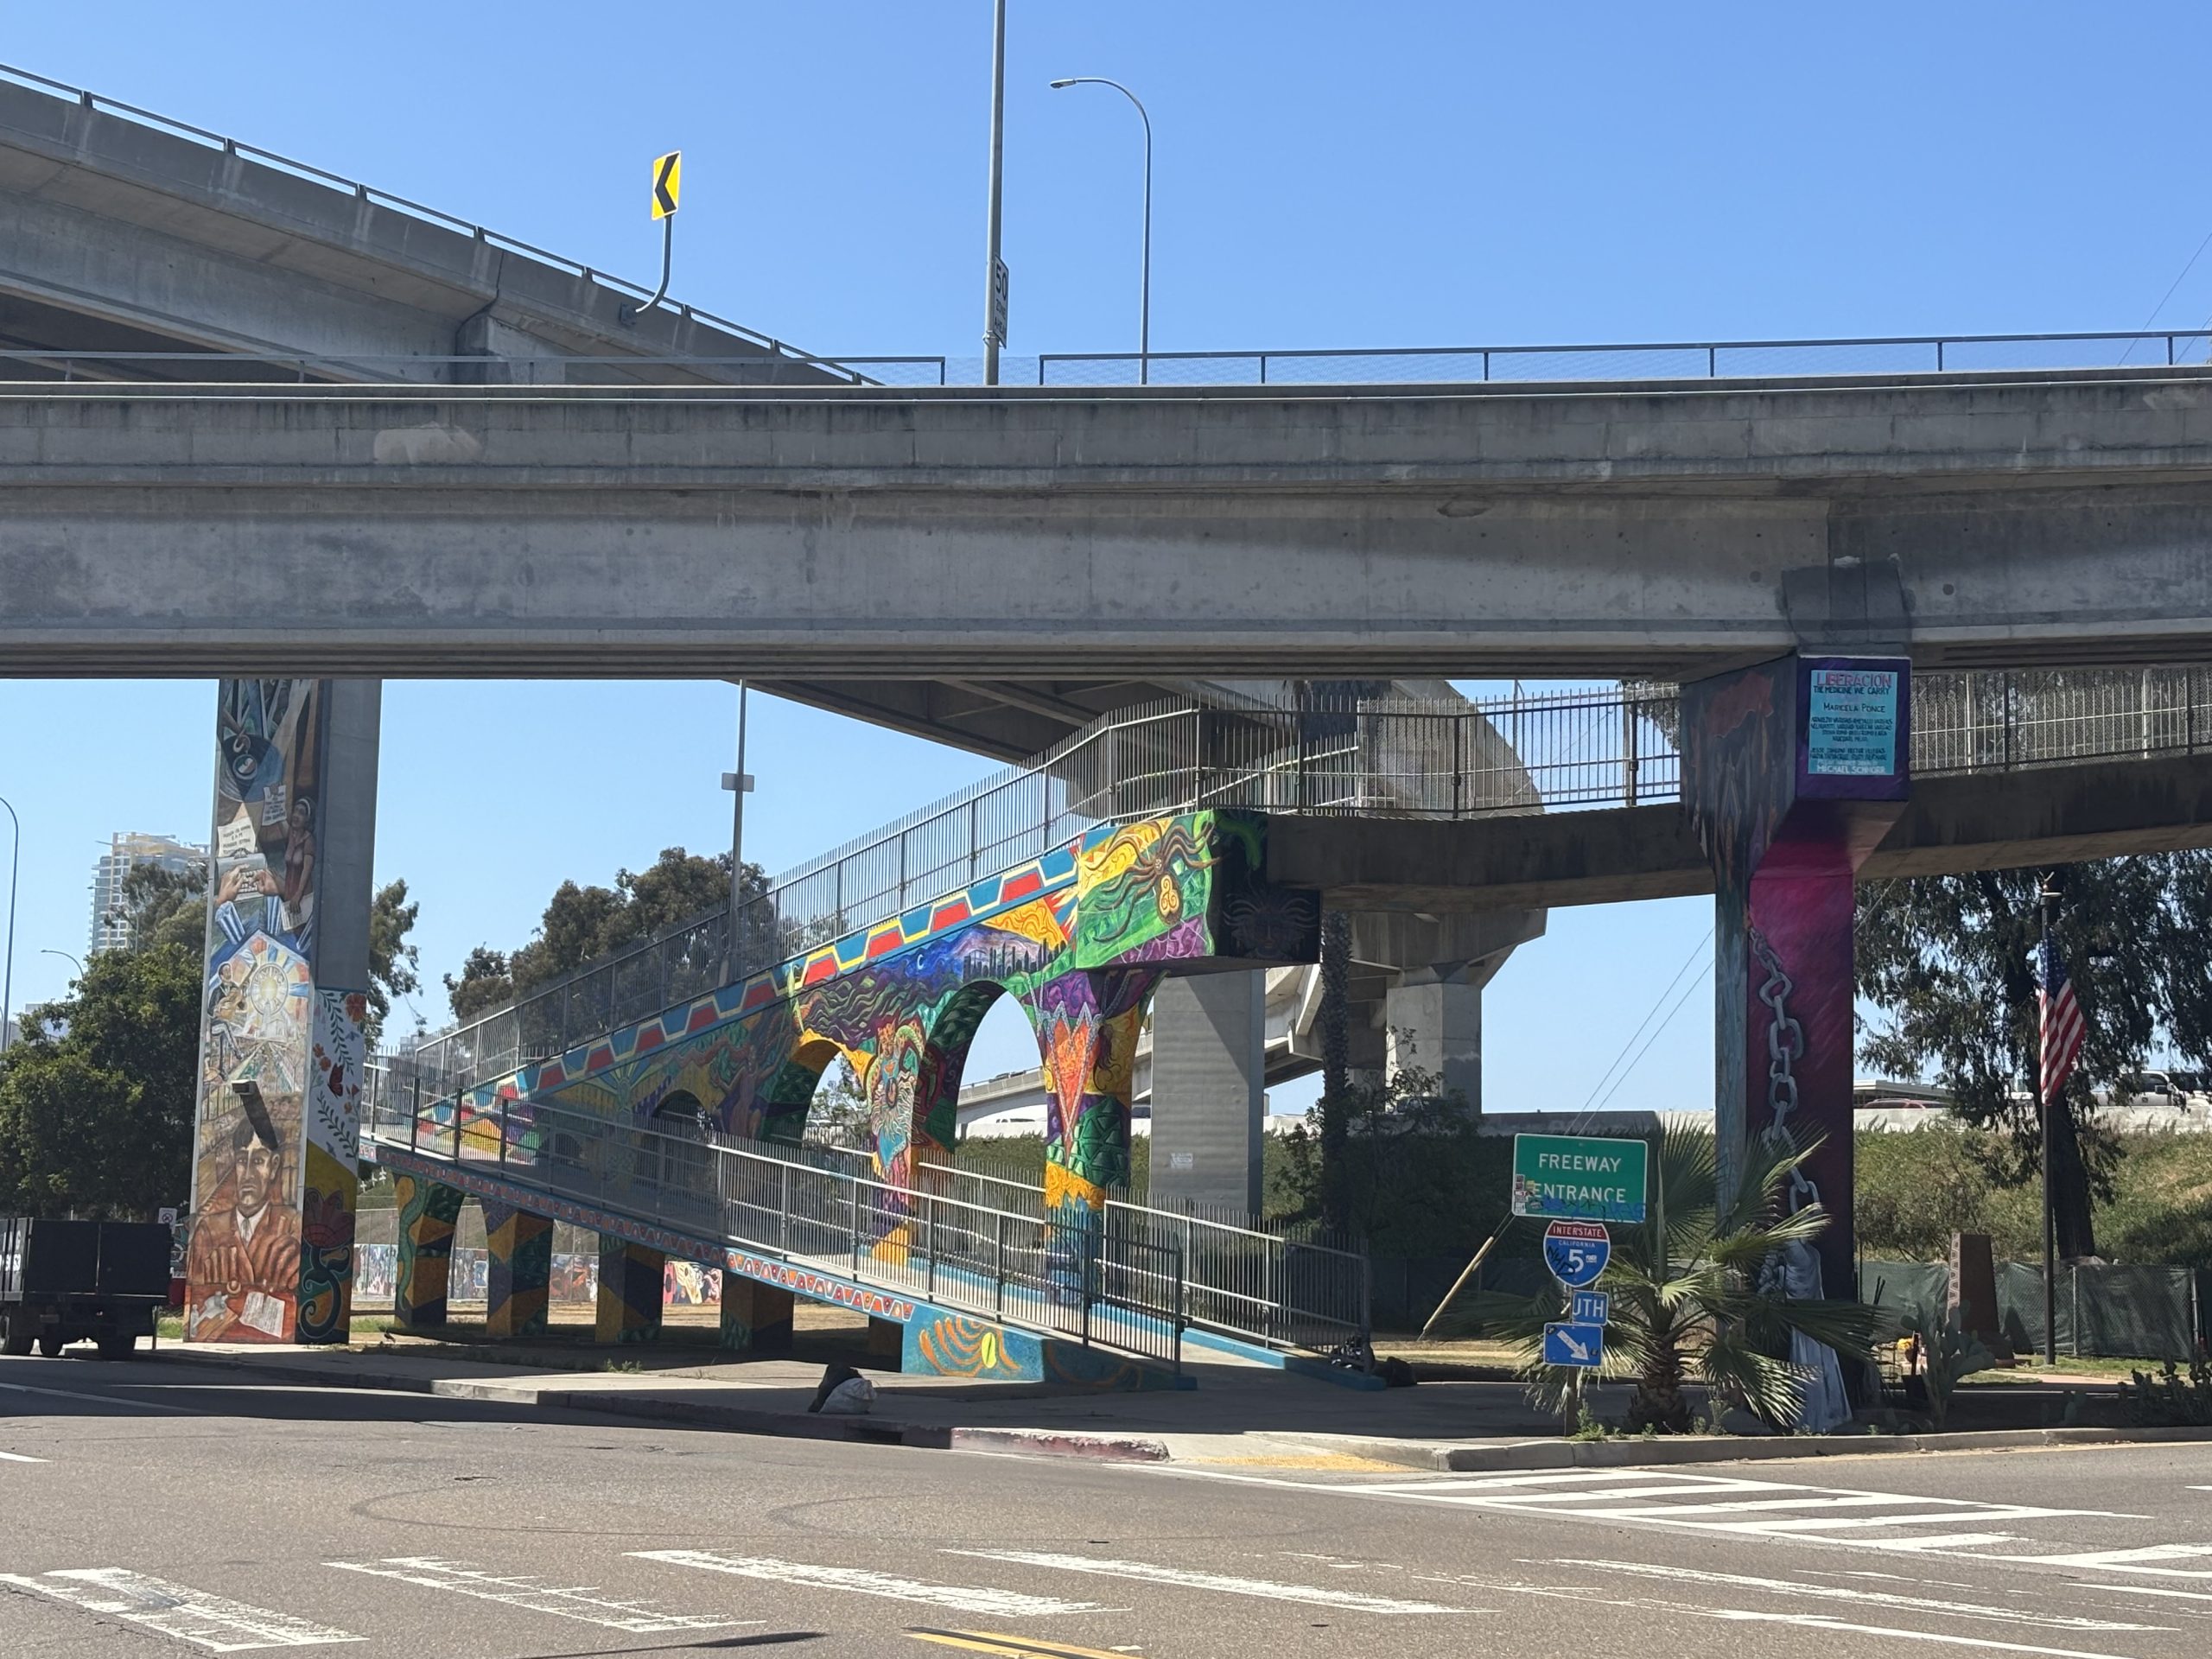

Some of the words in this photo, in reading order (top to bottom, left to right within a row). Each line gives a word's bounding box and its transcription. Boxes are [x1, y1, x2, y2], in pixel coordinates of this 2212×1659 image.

[995, 263, 1007, 301] 50
[1867, 686, 1890, 695] CARRY
[1862, 703, 1885, 713] PONCE
[1539, 1153, 1621, 1173] FREEWAY
[1531, 1183, 1626, 1203] ENTRANCE
[1553, 1225, 1602, 1237] INTERSTATE
[1558, 1239, 1595, 1248] CALIFORNIA
[1568, 1249, 1584, 1273] 5
[1573, 1297, 1604, 1318] UTH
